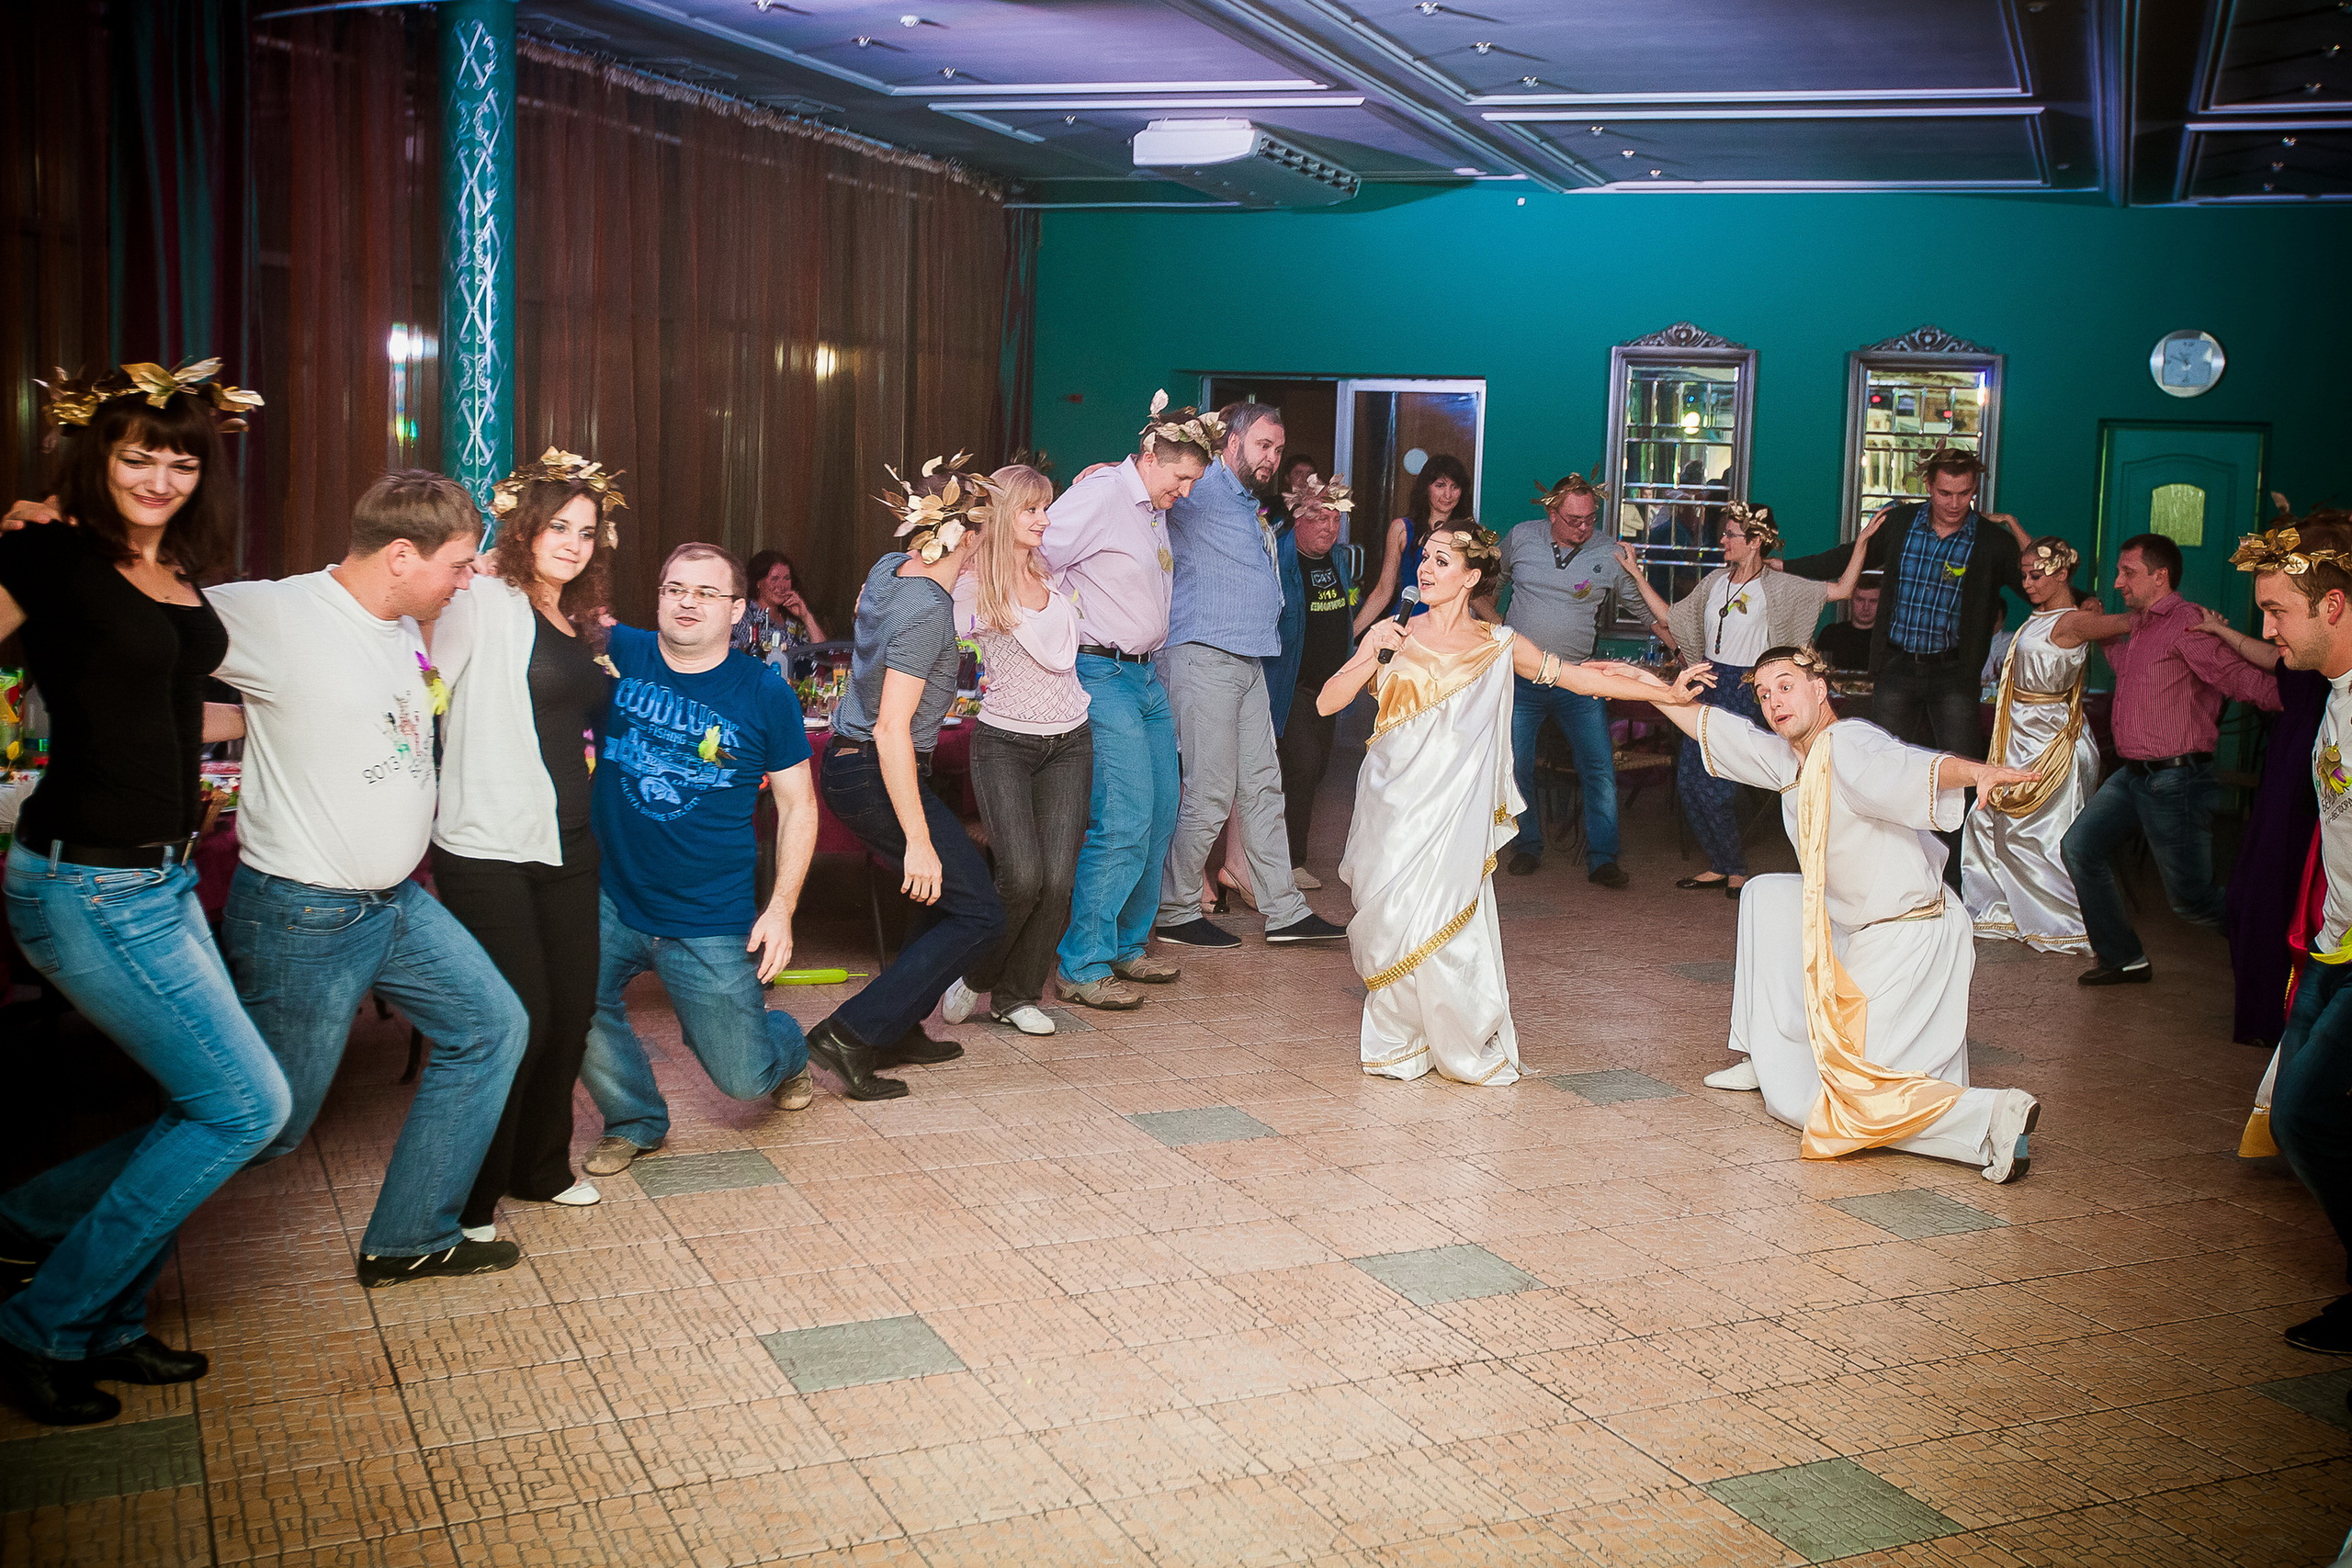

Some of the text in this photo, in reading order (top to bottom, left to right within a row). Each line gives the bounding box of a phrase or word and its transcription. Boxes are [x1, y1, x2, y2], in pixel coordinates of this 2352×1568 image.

[1314, 571, 1332, 583] CAT
[648, 724, 688, 745] FISHING
[361, 755, 401, 785] 2013
